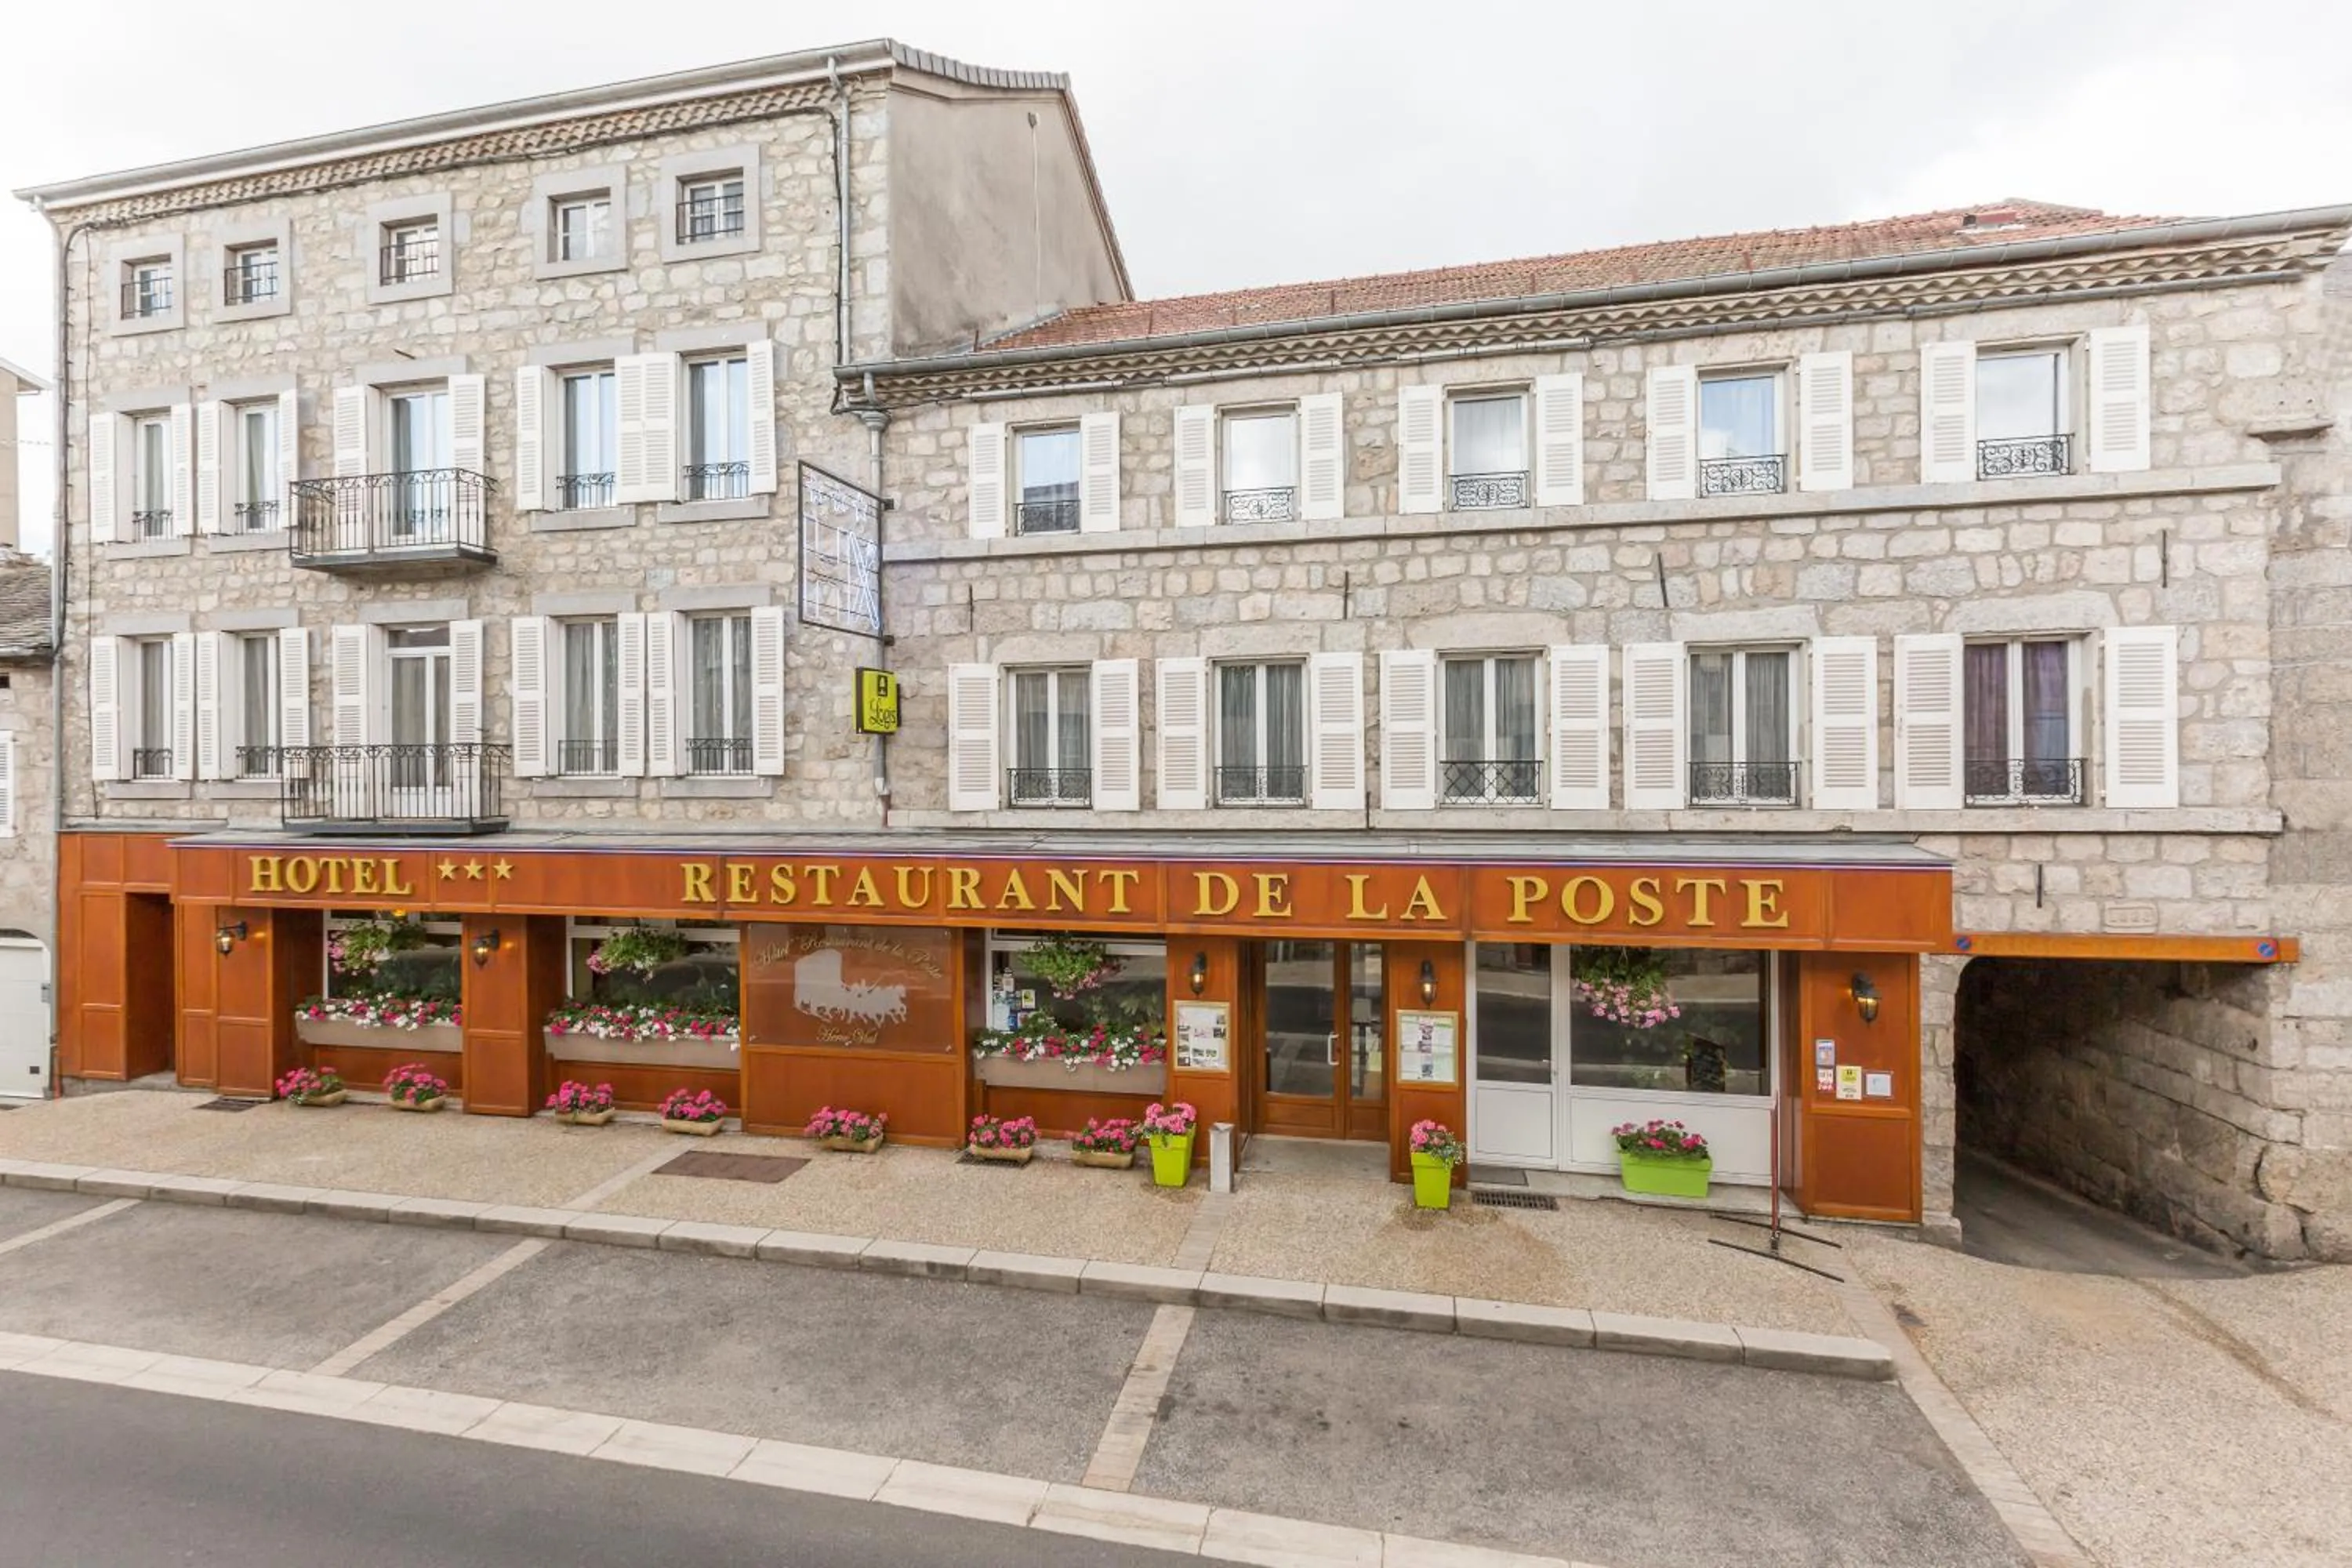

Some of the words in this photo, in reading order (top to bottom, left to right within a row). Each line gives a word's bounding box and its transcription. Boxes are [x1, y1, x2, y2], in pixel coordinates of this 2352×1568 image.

[868, 698, 896, 729] Logis
[249, 855, 412, 895] HOTEL
[681, 863, 1139, 913] RESTAURANT
[1192, 872, 1292, 917] DE
[1345, 874, 1447, 920] LA
[1507, 876, 1788, 928] POSTE
